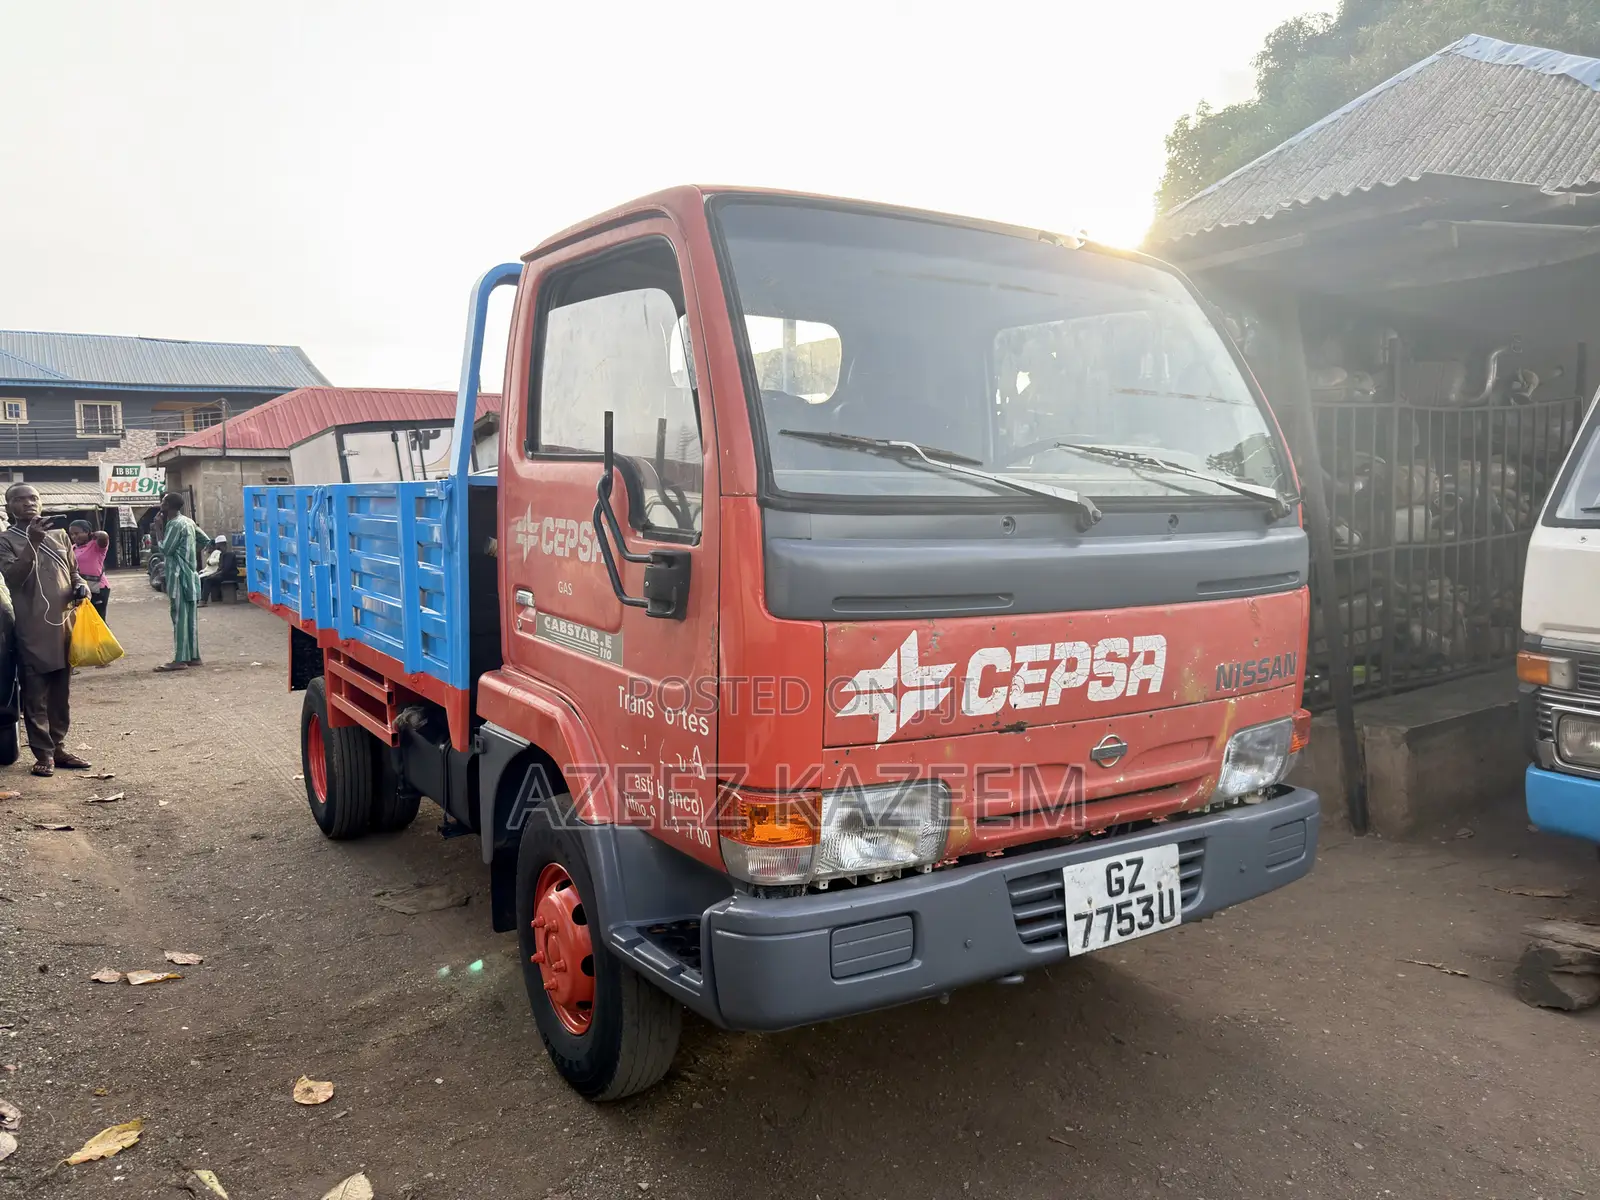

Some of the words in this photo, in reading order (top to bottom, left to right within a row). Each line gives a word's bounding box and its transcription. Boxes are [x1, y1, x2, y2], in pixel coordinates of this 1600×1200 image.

[115, 467, 124, 476] IB
[125, 467, 139, 476] BET
[557, 580, 573, 596] GAS
[961, 634, 1167, 716] CEPSA
[1215, 652, 1296, 692] NISSAN
[1105, 856, 1146, 898] GZ
[1074, 888, 1176, 949] 7753U
